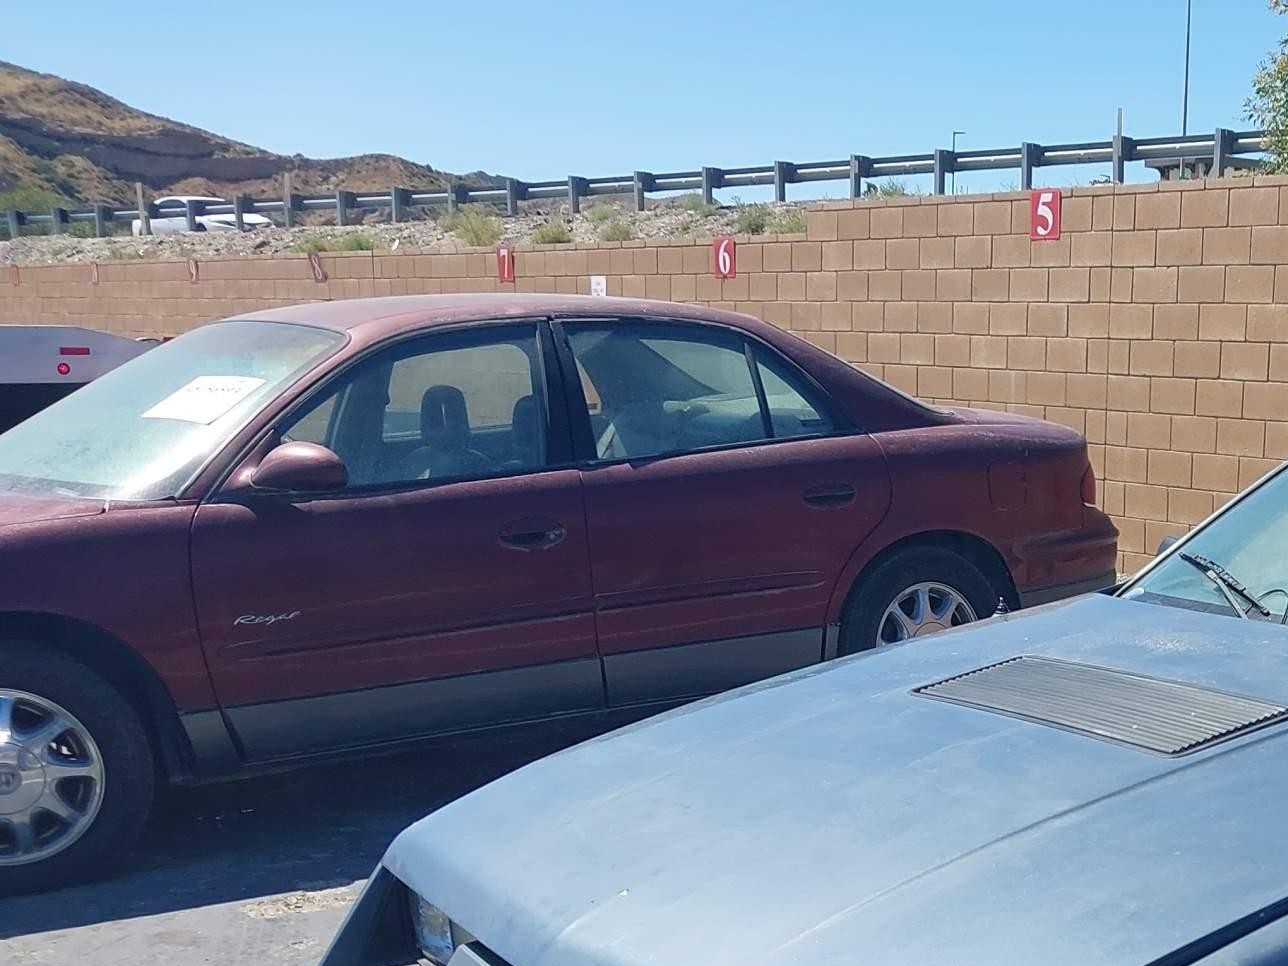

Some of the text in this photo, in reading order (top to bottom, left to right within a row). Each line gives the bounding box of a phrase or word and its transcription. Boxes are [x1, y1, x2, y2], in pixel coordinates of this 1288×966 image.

[1036, 192, 1054, 236] 5
[311, 254, 323, 280] 8
[499, 248, 508, 279] 7
[718, 239, 731, 274] 6
